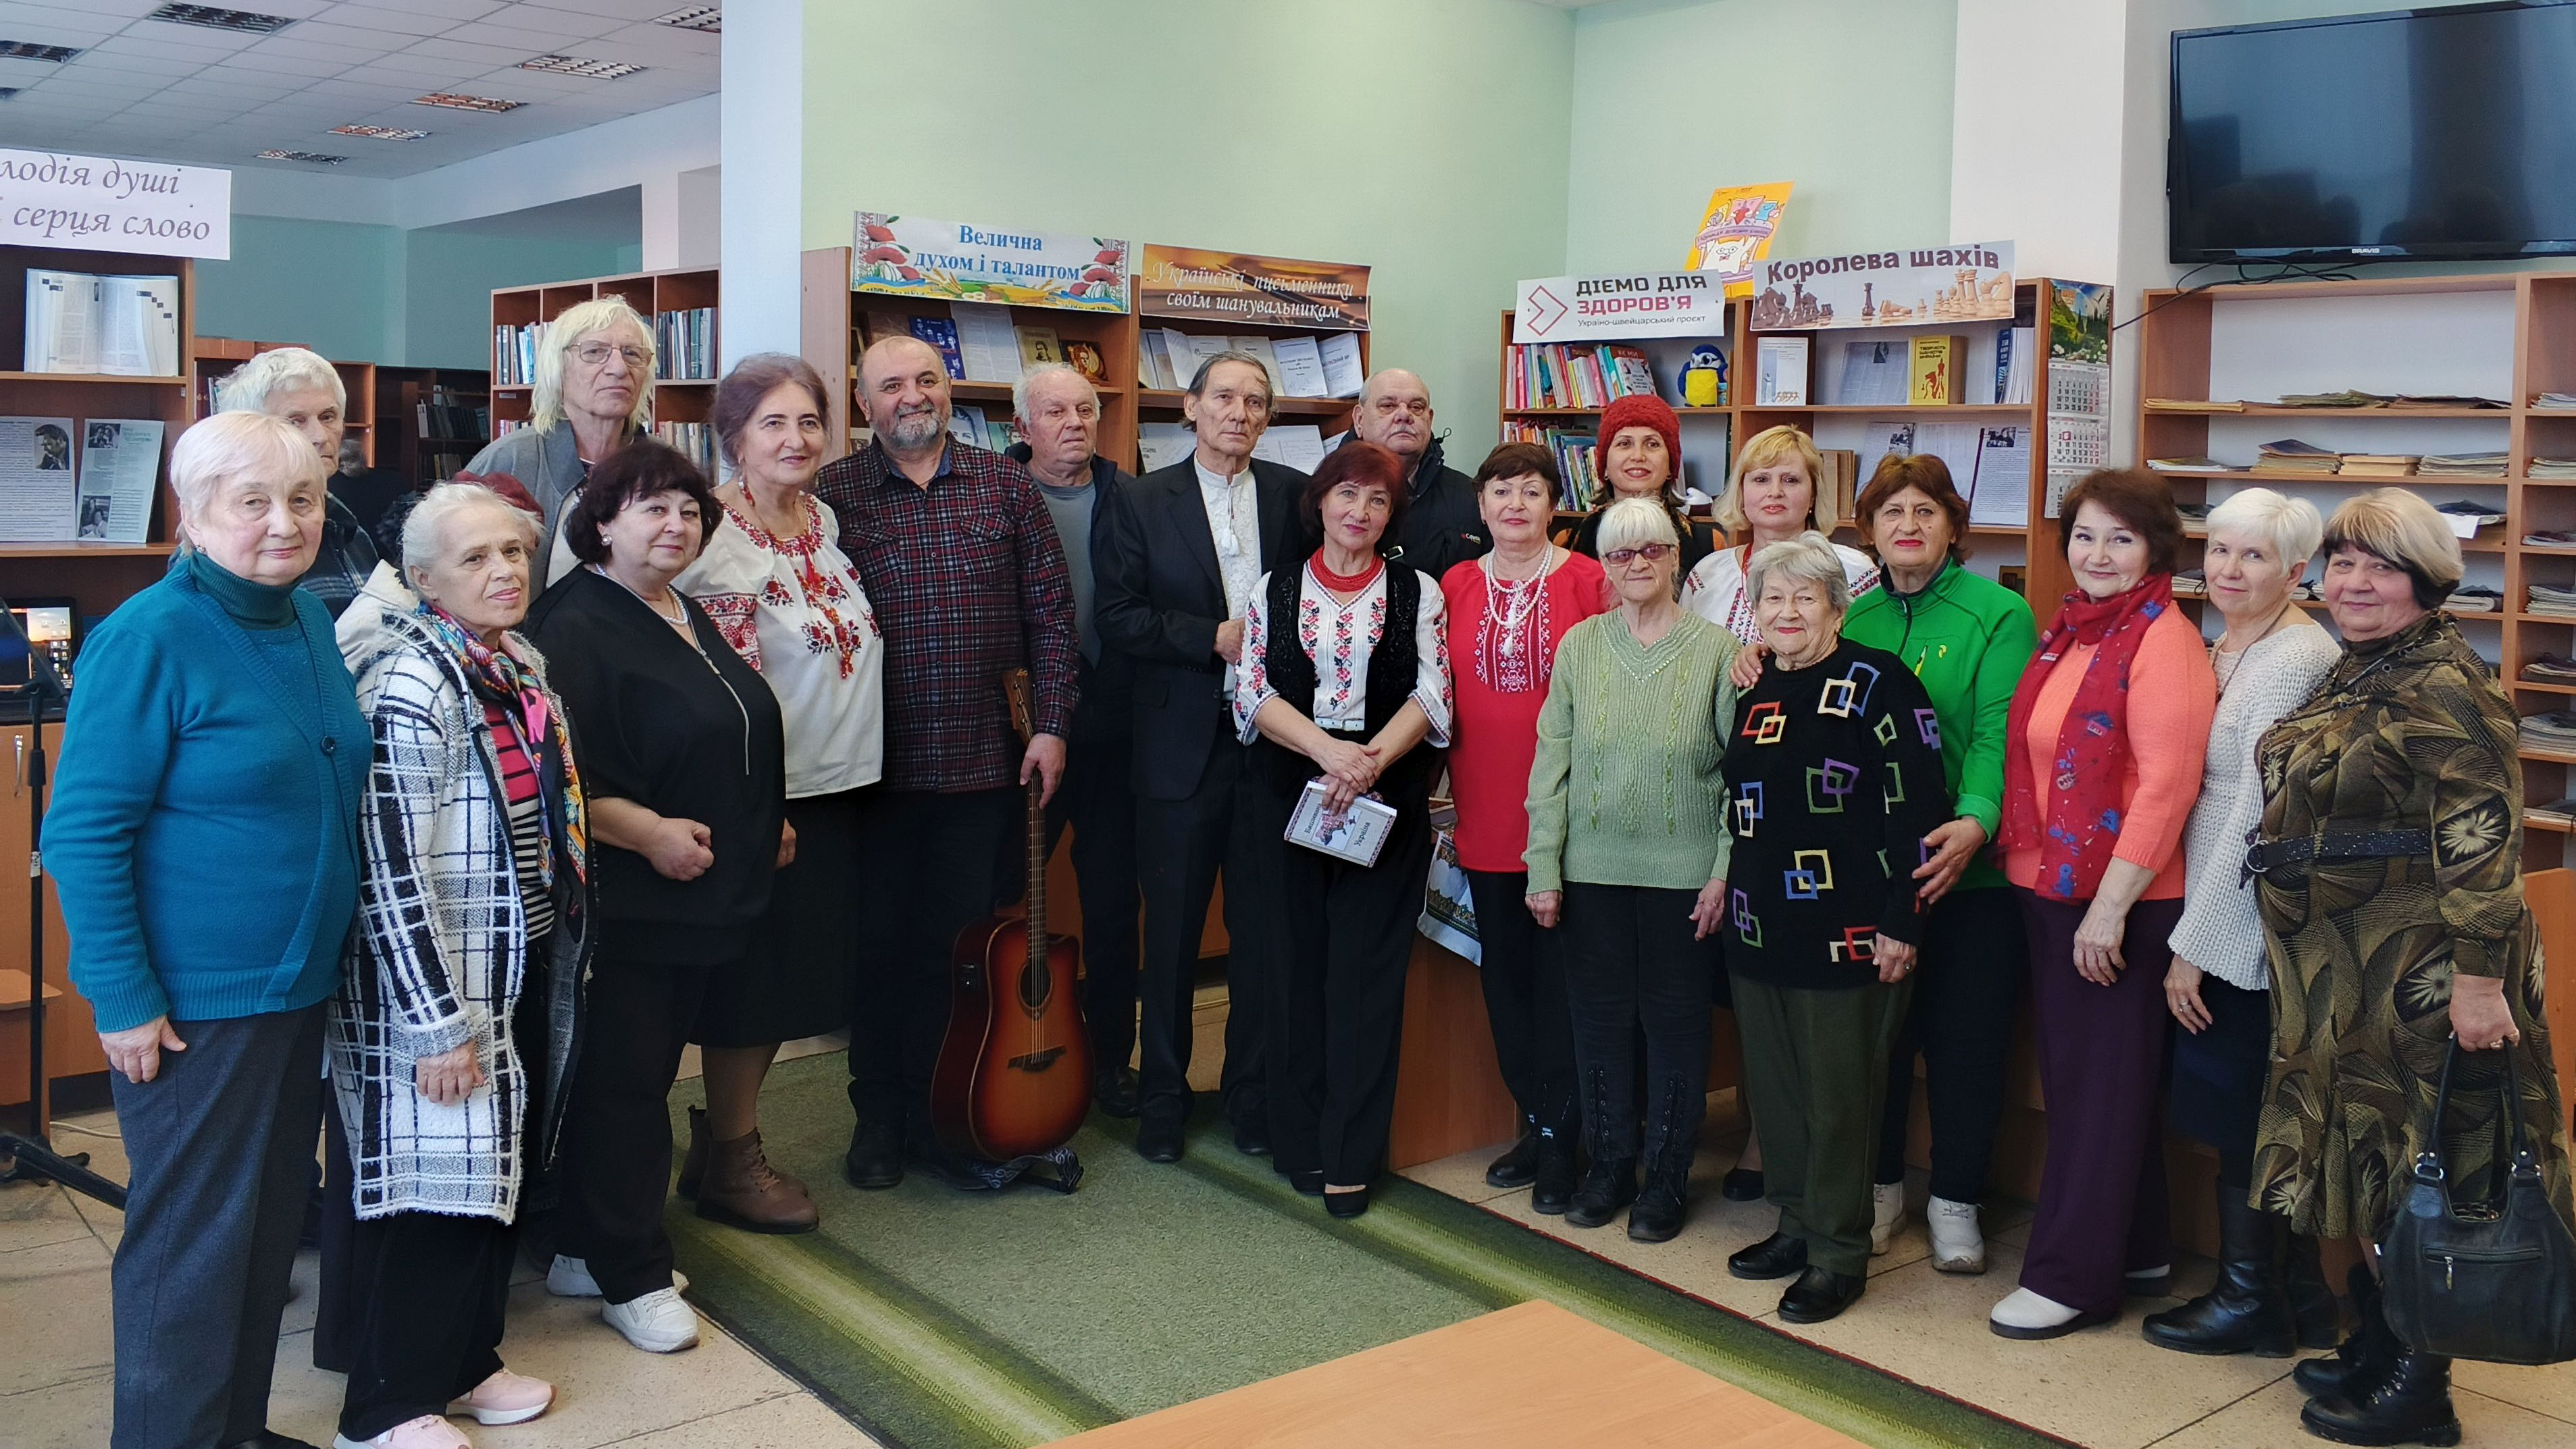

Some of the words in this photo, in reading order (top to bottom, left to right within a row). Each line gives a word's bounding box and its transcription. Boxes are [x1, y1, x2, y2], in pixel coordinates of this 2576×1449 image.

[103, 160, 182, 199] душі
[14, 206, 111, 238] серця
[123, 215, 210, 240] слово
[958, 224, 1043, 251] Велична
[914, 252, 973, 272] духом
[979, 255, 985, 272] і
[991, 259, 1080, 281] талантом
[1768, 252, 1899, 284] Королева
[1909, 244, 1999, 269] шахів
[1152, 261, 1246, 292] Українські
[1254, 275, 1354, 300] письменники
[1576, 278, 1649, 296] ДІЄМО
[1657, 275, 1707, 292] ДЛЯ
[1166, 292, 1210, 310] своїм
[1216, 296, 1340, 321] шанувальникам
[1577, 295, 1692, 315] ЗДОРОВ'Я
[1676, 315, 1706, 324] проєкт
[1354, 822, 1370, 847] Україна
